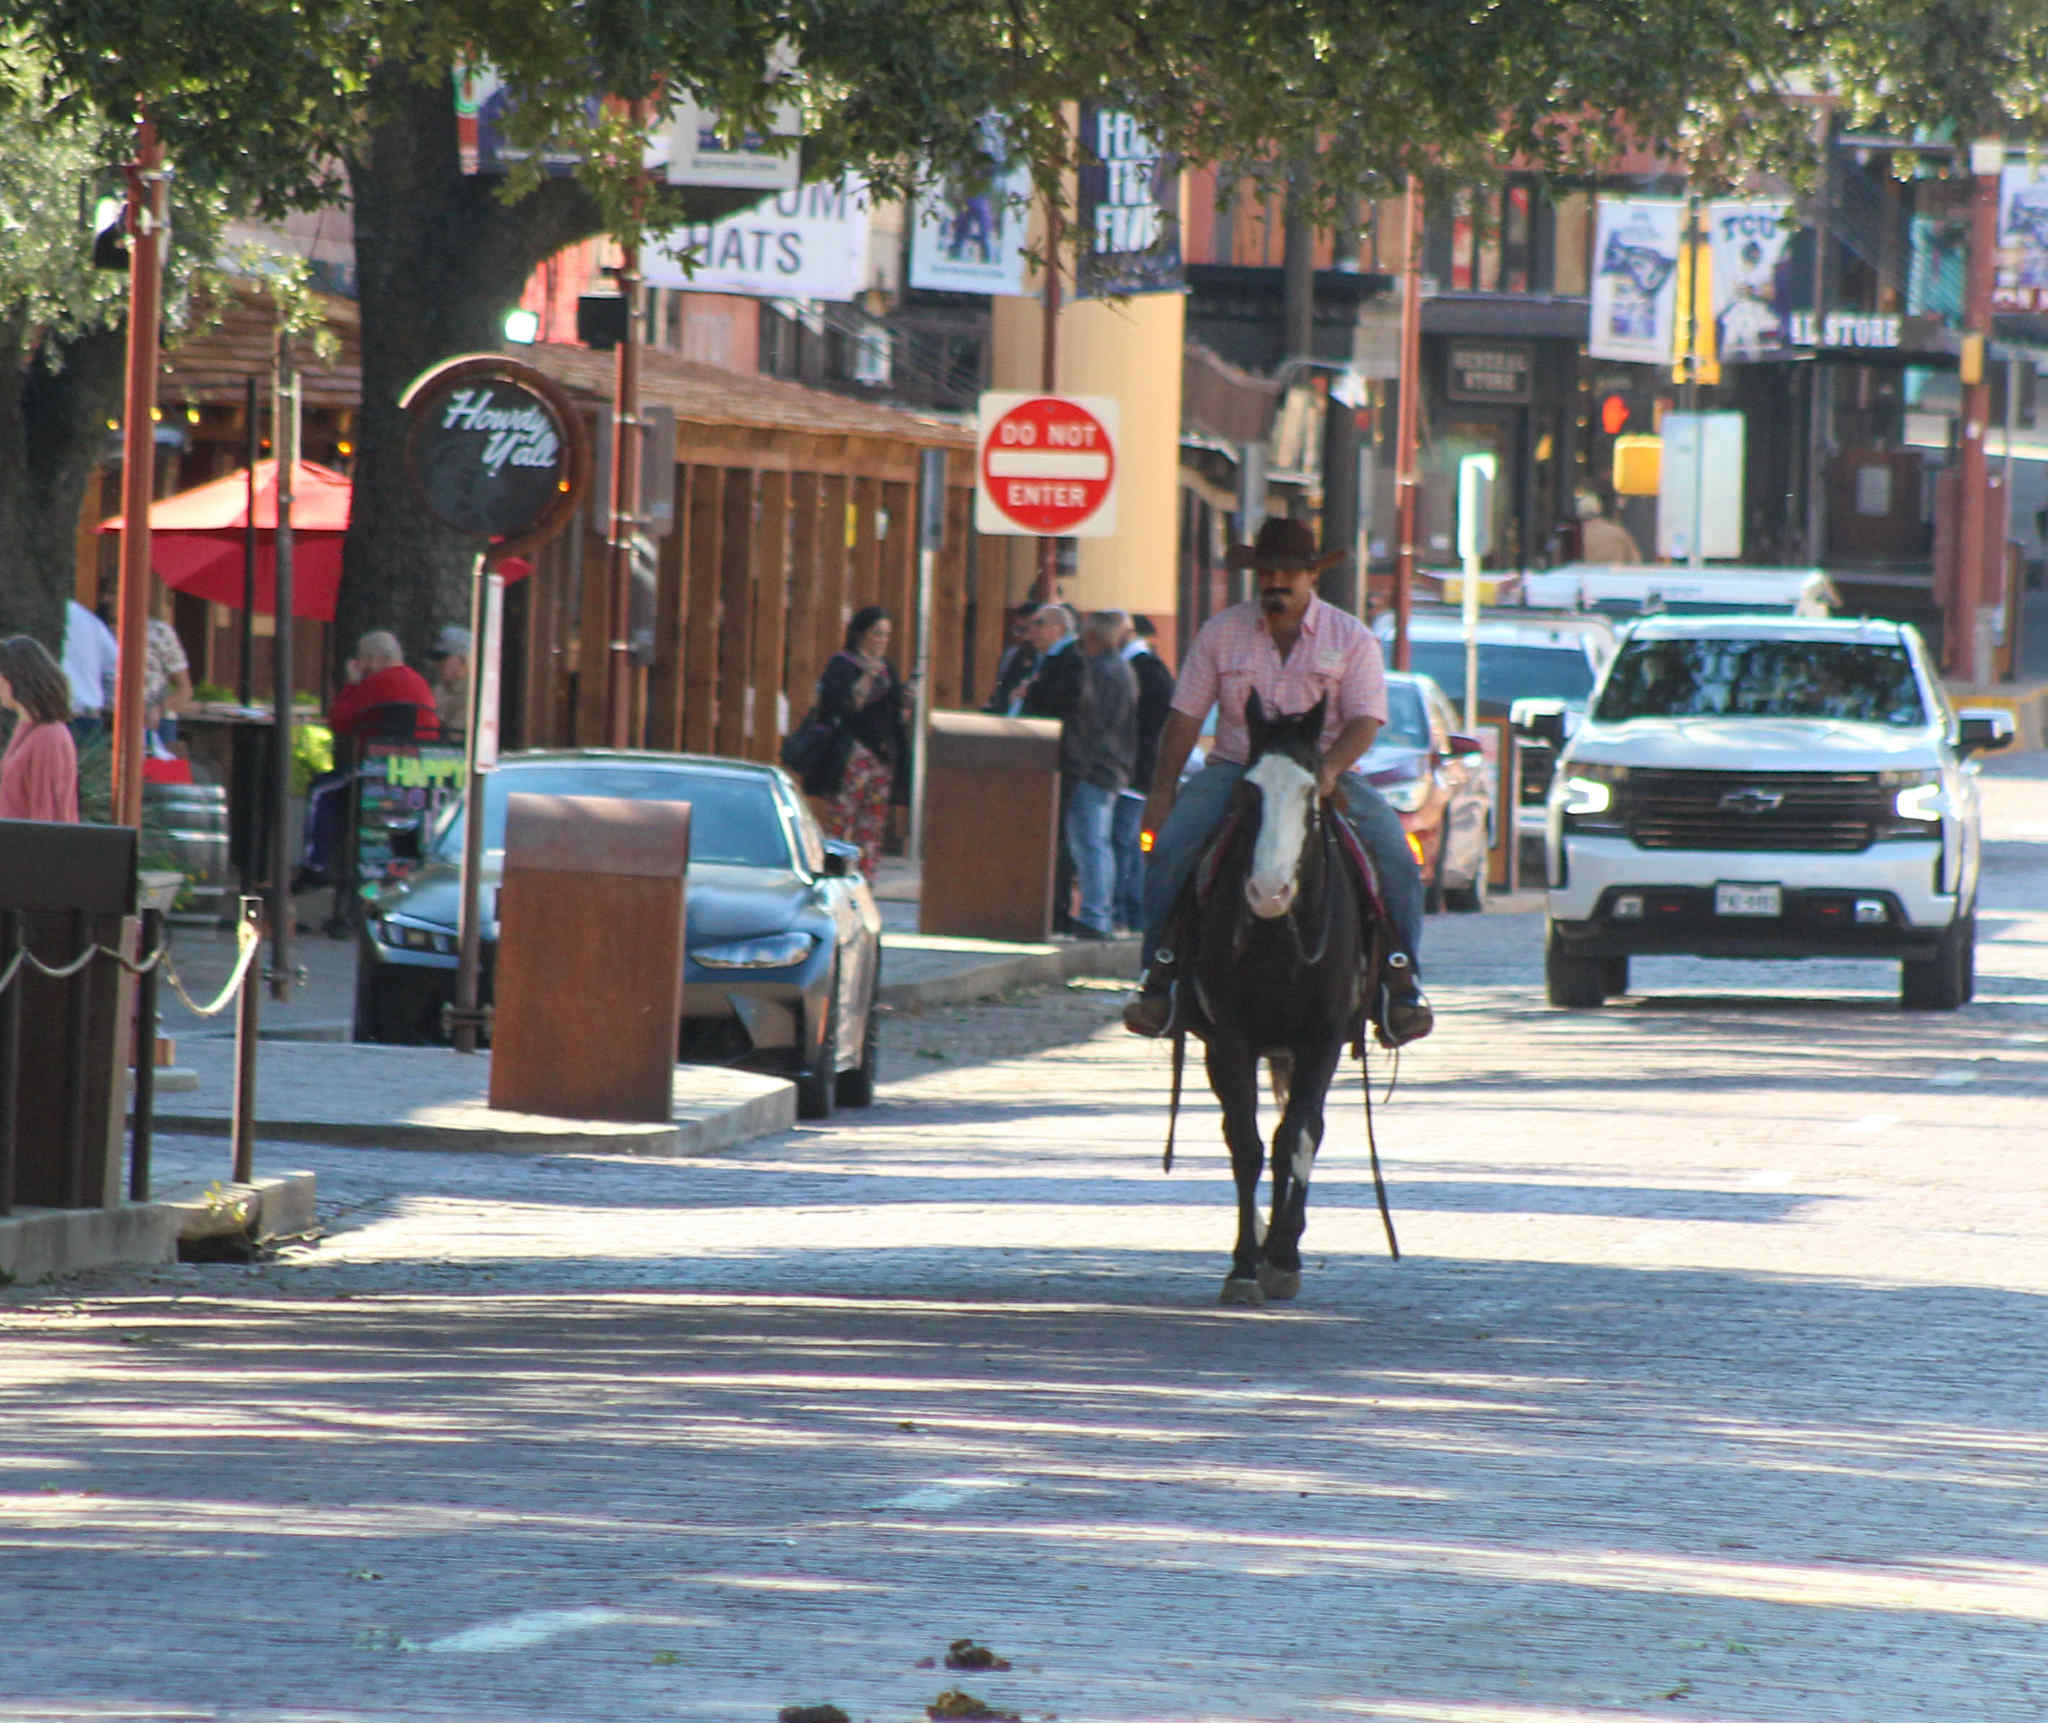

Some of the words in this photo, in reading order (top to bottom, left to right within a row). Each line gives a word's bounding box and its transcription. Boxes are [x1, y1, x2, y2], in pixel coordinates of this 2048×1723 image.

[1722, 216, 1778, 241] TCU
[688, 226, 803, 274] HATS
[1824, 312, 1901, 346] STORE
[442, 390, 551, 444] Howdy
[1001, 422, 1037, 446] DO
[1046, 424, 1097, 447] NOT
[1008, 484, 1087, 507] ENTER
